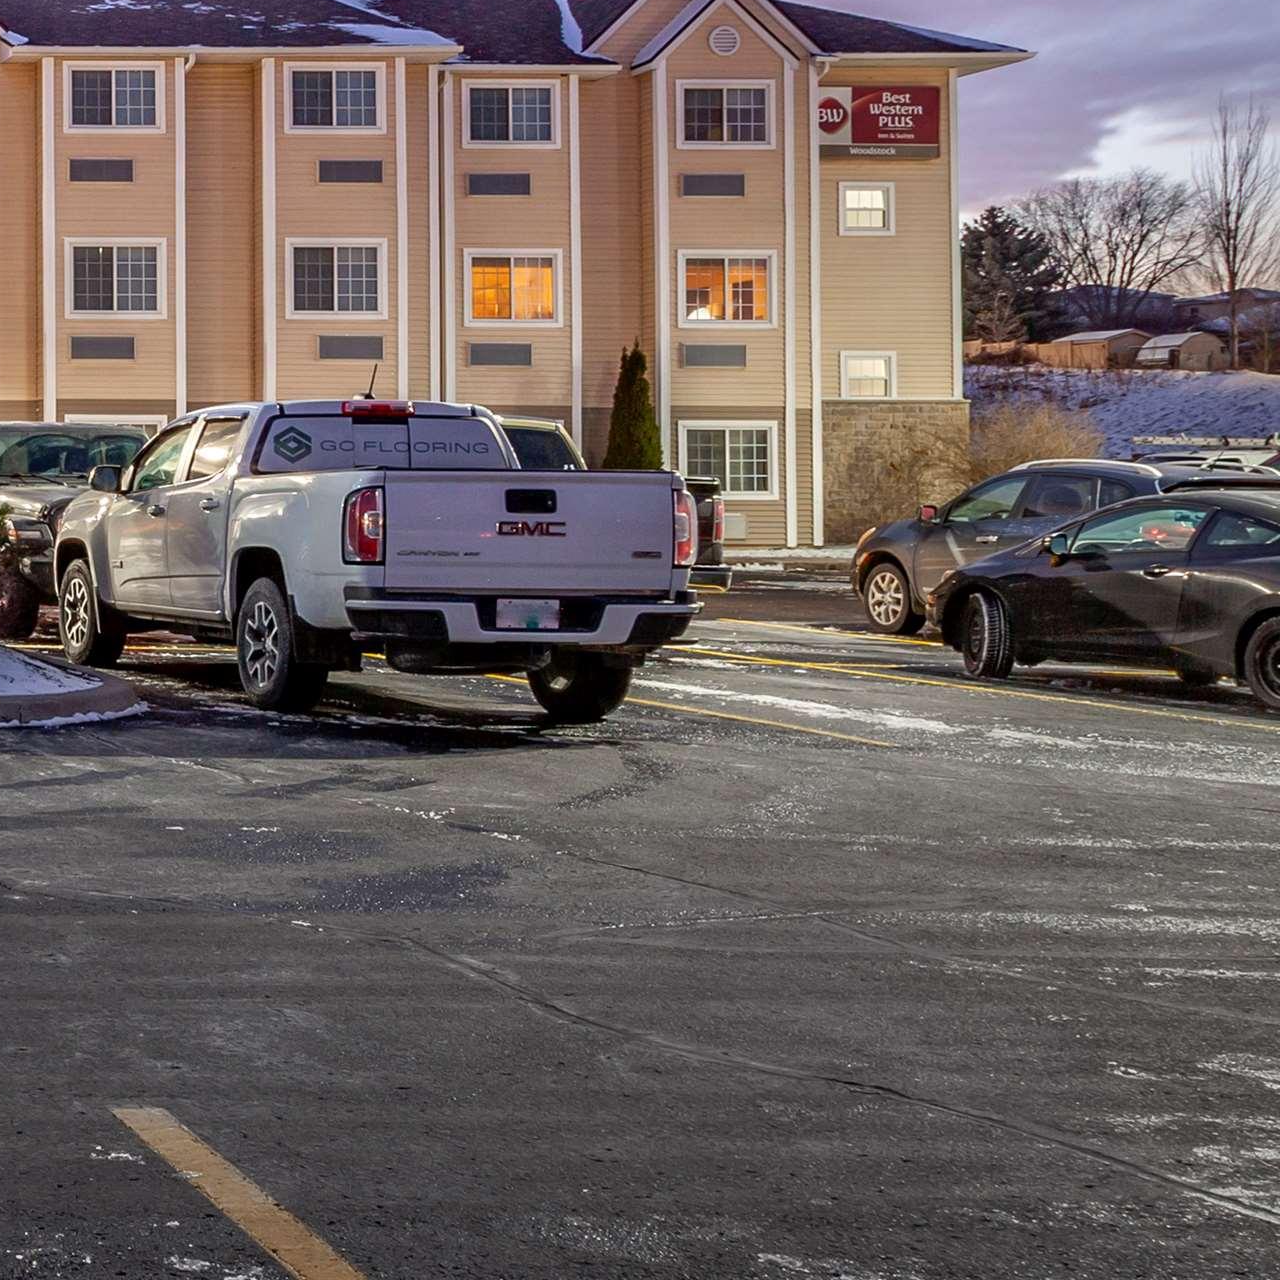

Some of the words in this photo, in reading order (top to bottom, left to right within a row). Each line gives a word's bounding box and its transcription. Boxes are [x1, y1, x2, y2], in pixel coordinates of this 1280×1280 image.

[882, 92, 911, 103] Best
[869, 104, 923, 115] Western
[879, 116, 913, 128] PLUS
[849, 146, 896, 156] Woodstock
[320, 439, 356, 452] GO
[363, 440, 489, 454] FLOORING
[496, 521, 566, 537] GMC
